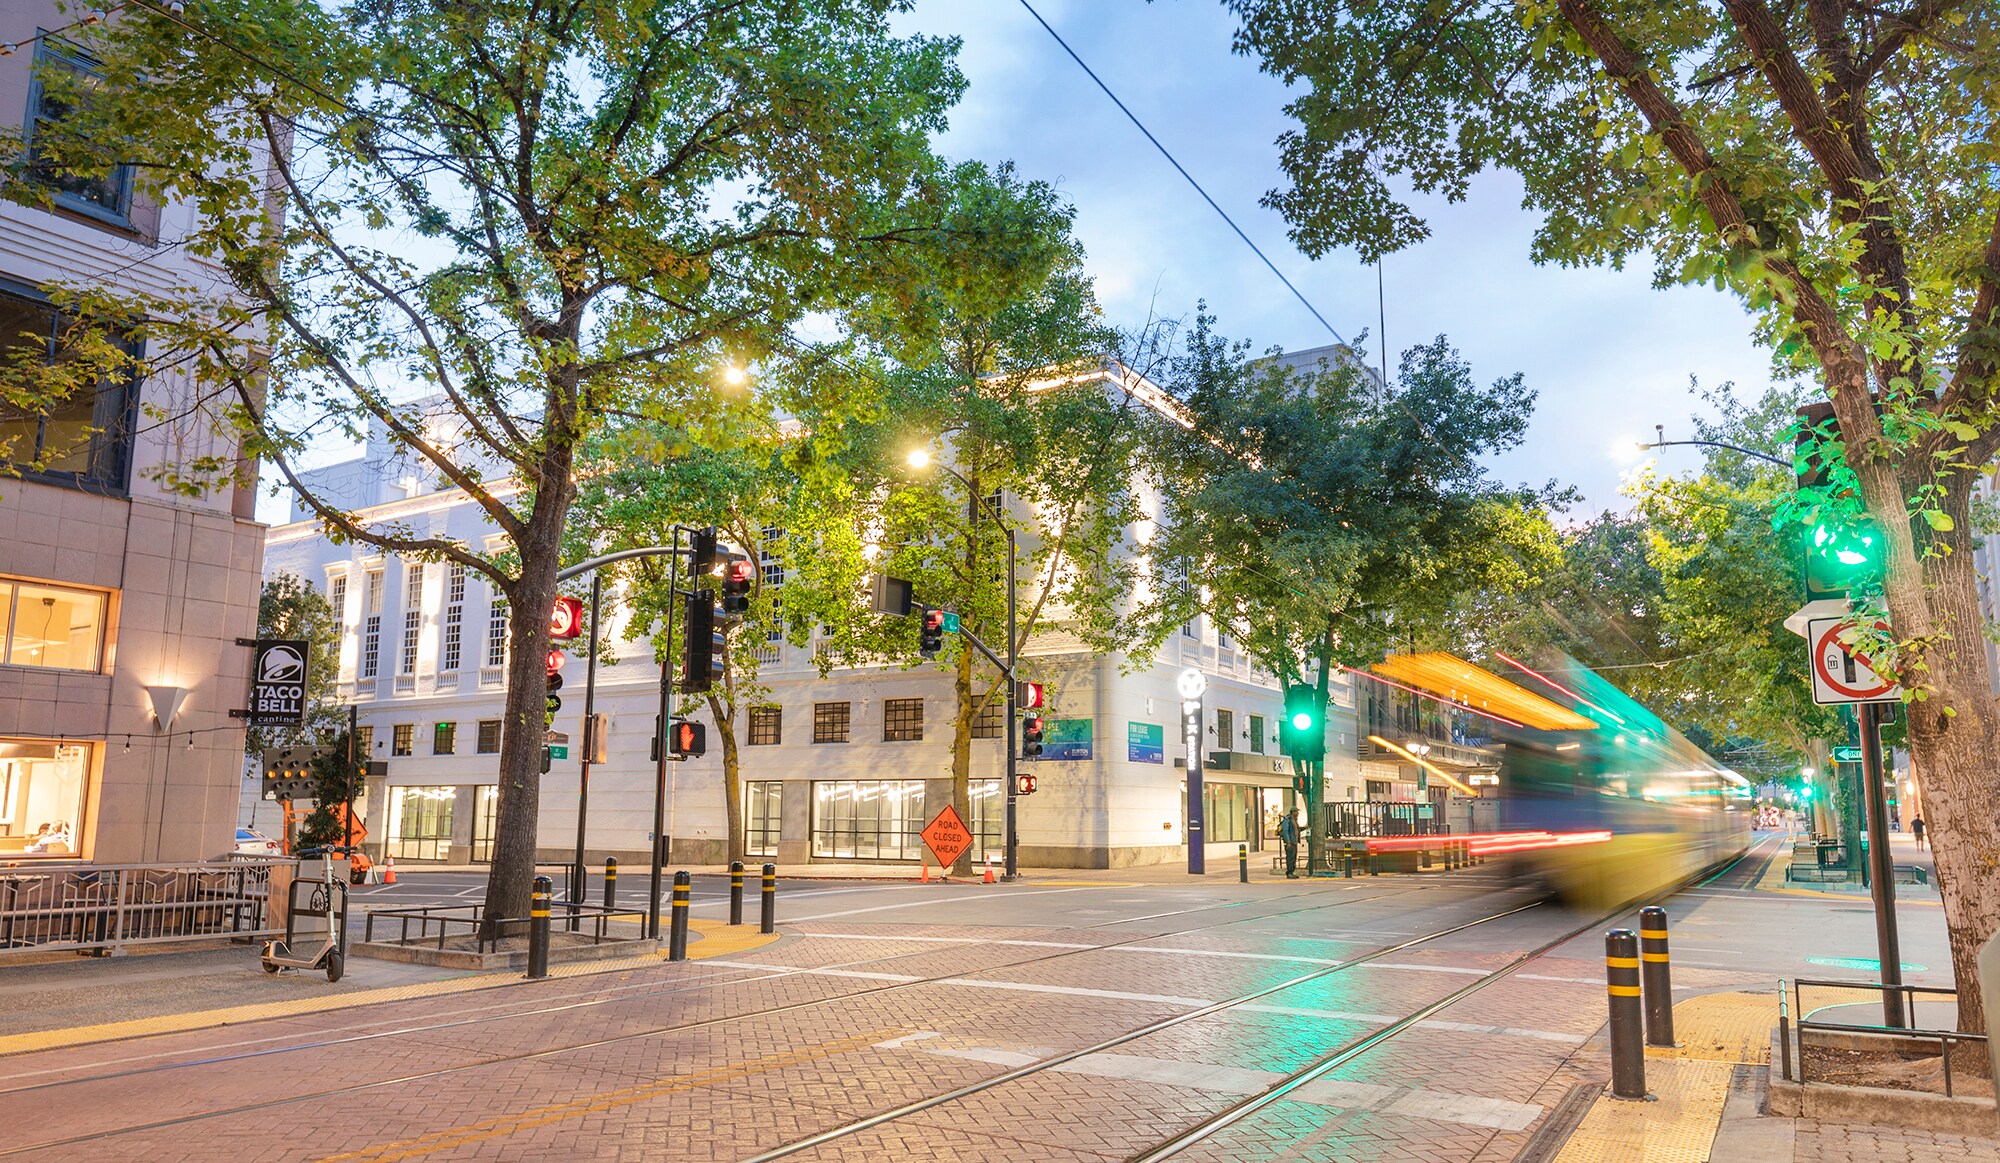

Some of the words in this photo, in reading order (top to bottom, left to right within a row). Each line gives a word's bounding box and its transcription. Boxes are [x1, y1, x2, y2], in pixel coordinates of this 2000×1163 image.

[256, 685, 302, 699] TACO
[257, 699, 300, 713] BELL
[938, 820, 959, 830] ROAD
[933, 832, 962, 843] CLOSED
[935, 844, 959, 854] AHEAD
